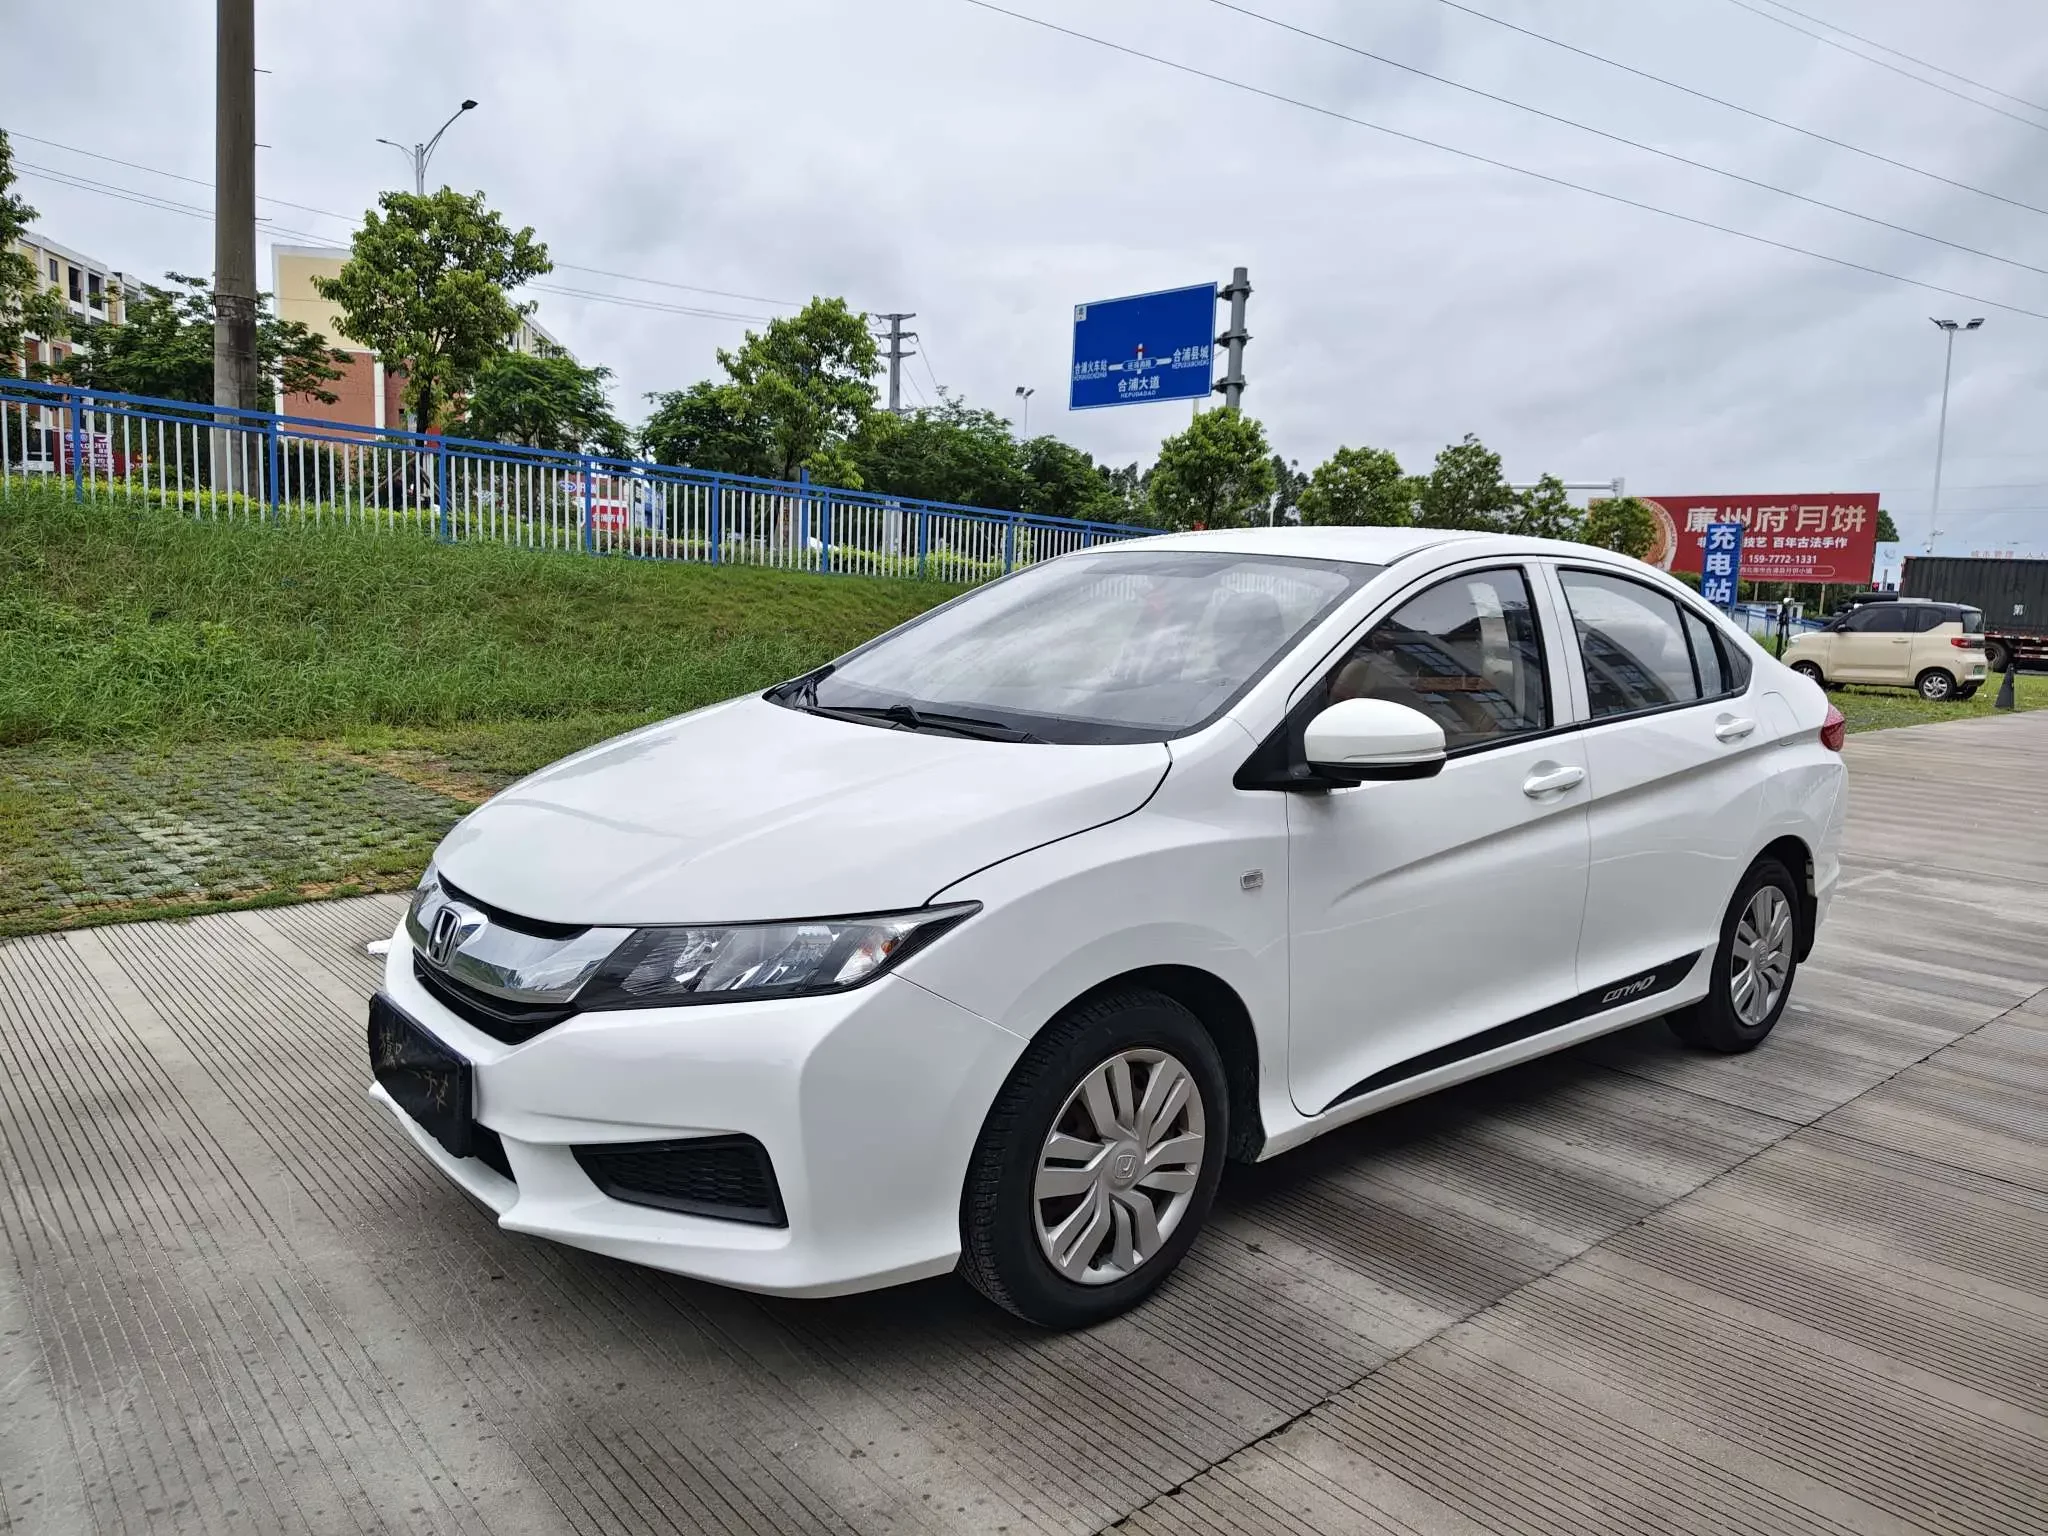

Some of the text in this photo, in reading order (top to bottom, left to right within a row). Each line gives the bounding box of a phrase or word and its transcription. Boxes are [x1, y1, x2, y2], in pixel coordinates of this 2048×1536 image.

[1173, 344, 1209, 362] 合浦县城
[1075, 359, 1108, 375] 合浦火车站
[1118, 375, 1160, 392] 合浦大道
[1772, 536, 1849, 549] 百年古法手作
[1704, 525, 1737, 604] 充电站
[1748, 554, 1817, 565] 159-7772-1331
